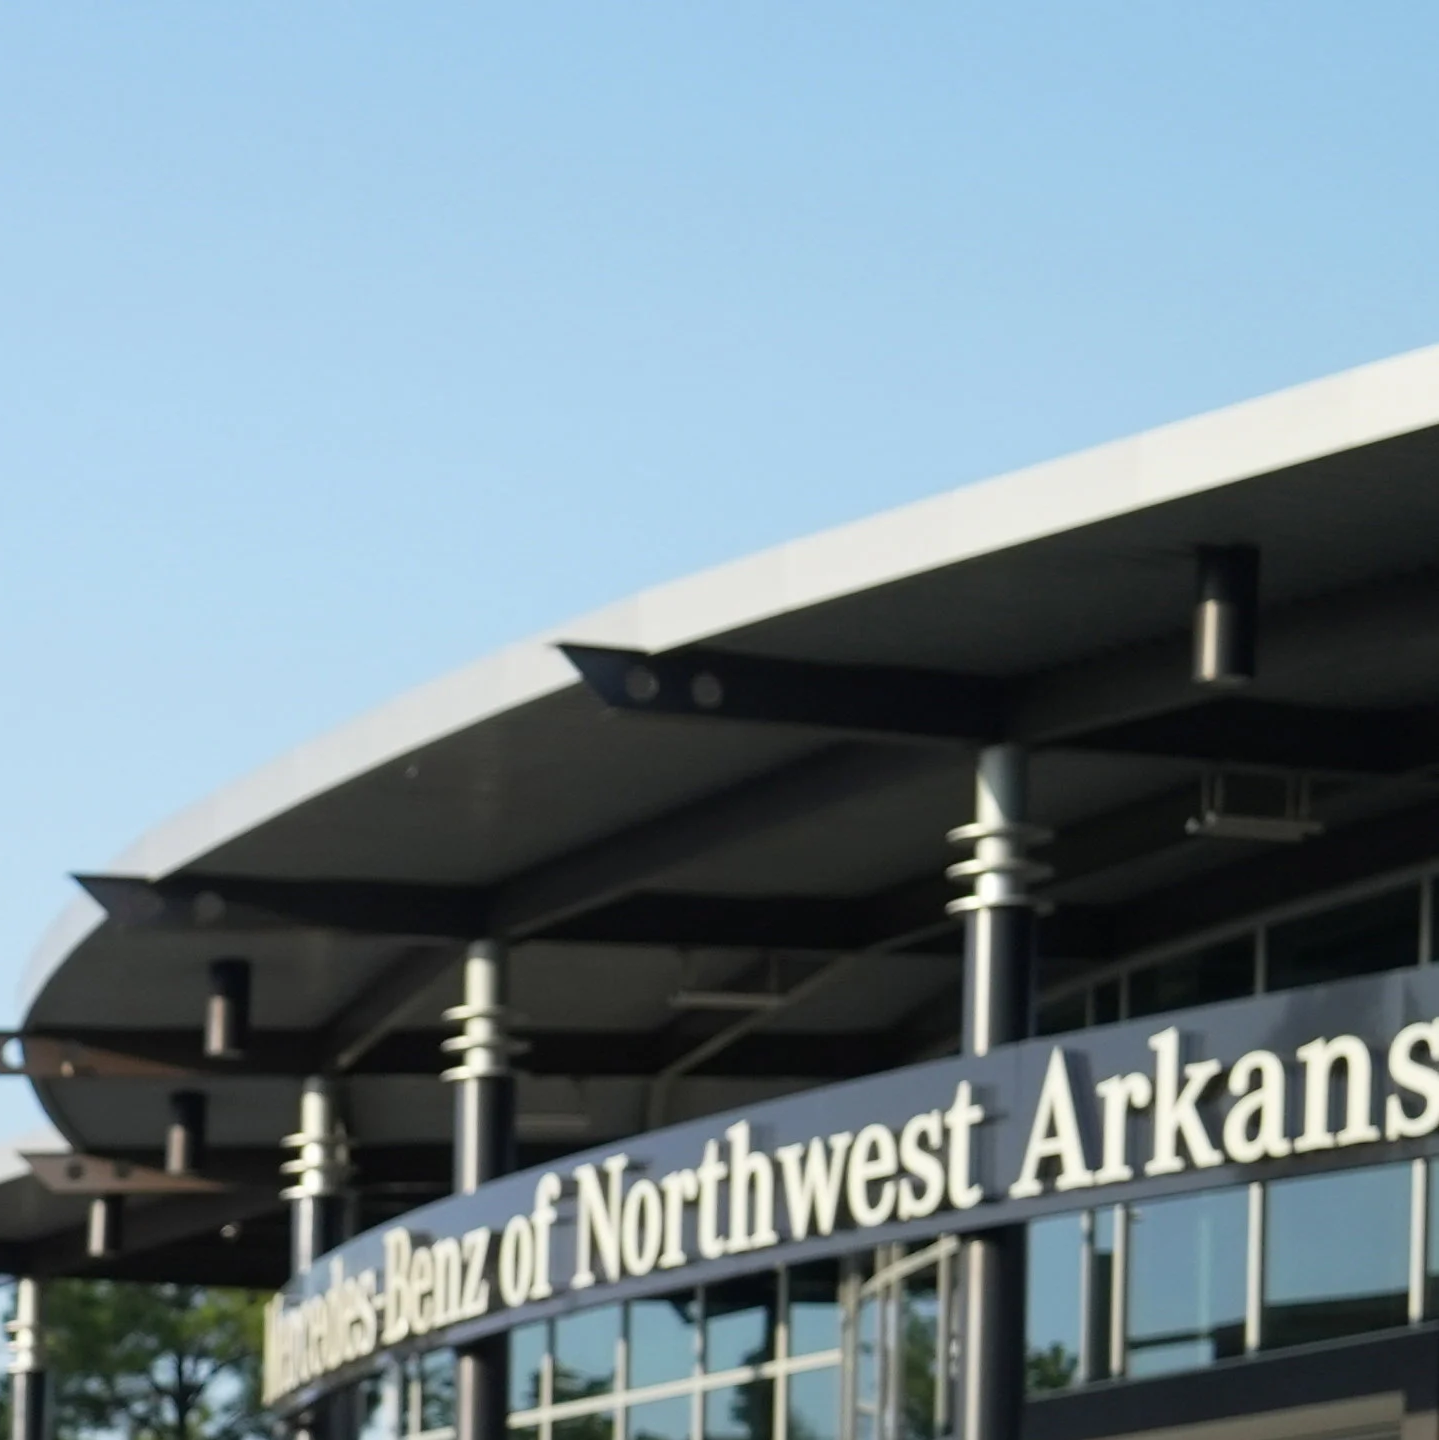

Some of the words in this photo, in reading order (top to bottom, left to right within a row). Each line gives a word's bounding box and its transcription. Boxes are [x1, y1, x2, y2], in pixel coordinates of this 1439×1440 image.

[498, 1171, 562, 1308] of
[569, 1080, 984, 1290] Northwest
[1009, 1016, 1439, 1200] Arkans
